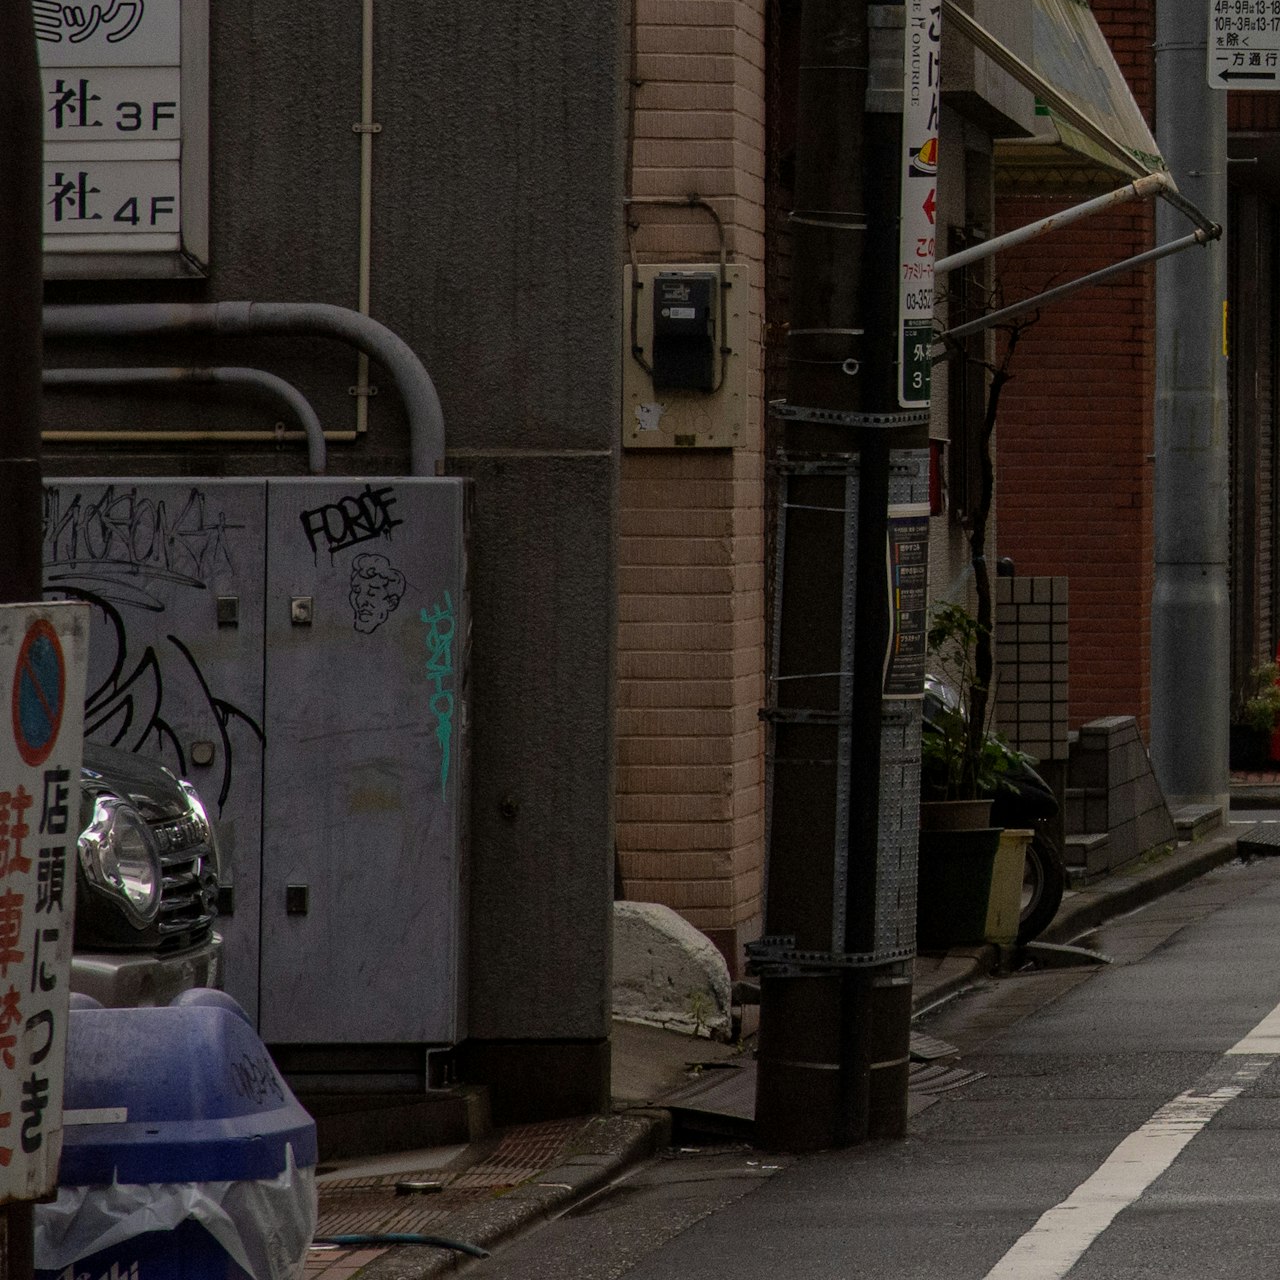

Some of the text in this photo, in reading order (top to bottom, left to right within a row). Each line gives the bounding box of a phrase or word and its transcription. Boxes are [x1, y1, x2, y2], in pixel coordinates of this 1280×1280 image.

[1215, 52, 1278, 67] 一方通行
[1216, 33, 1249, 47] を除く
[911, 32, 921, 107] OMURICE
[48, 78, 176, 131] 社 3F
[48, 171, 176, 226] 社 4F
[20, 764, 71, 1154] 店頭につき
